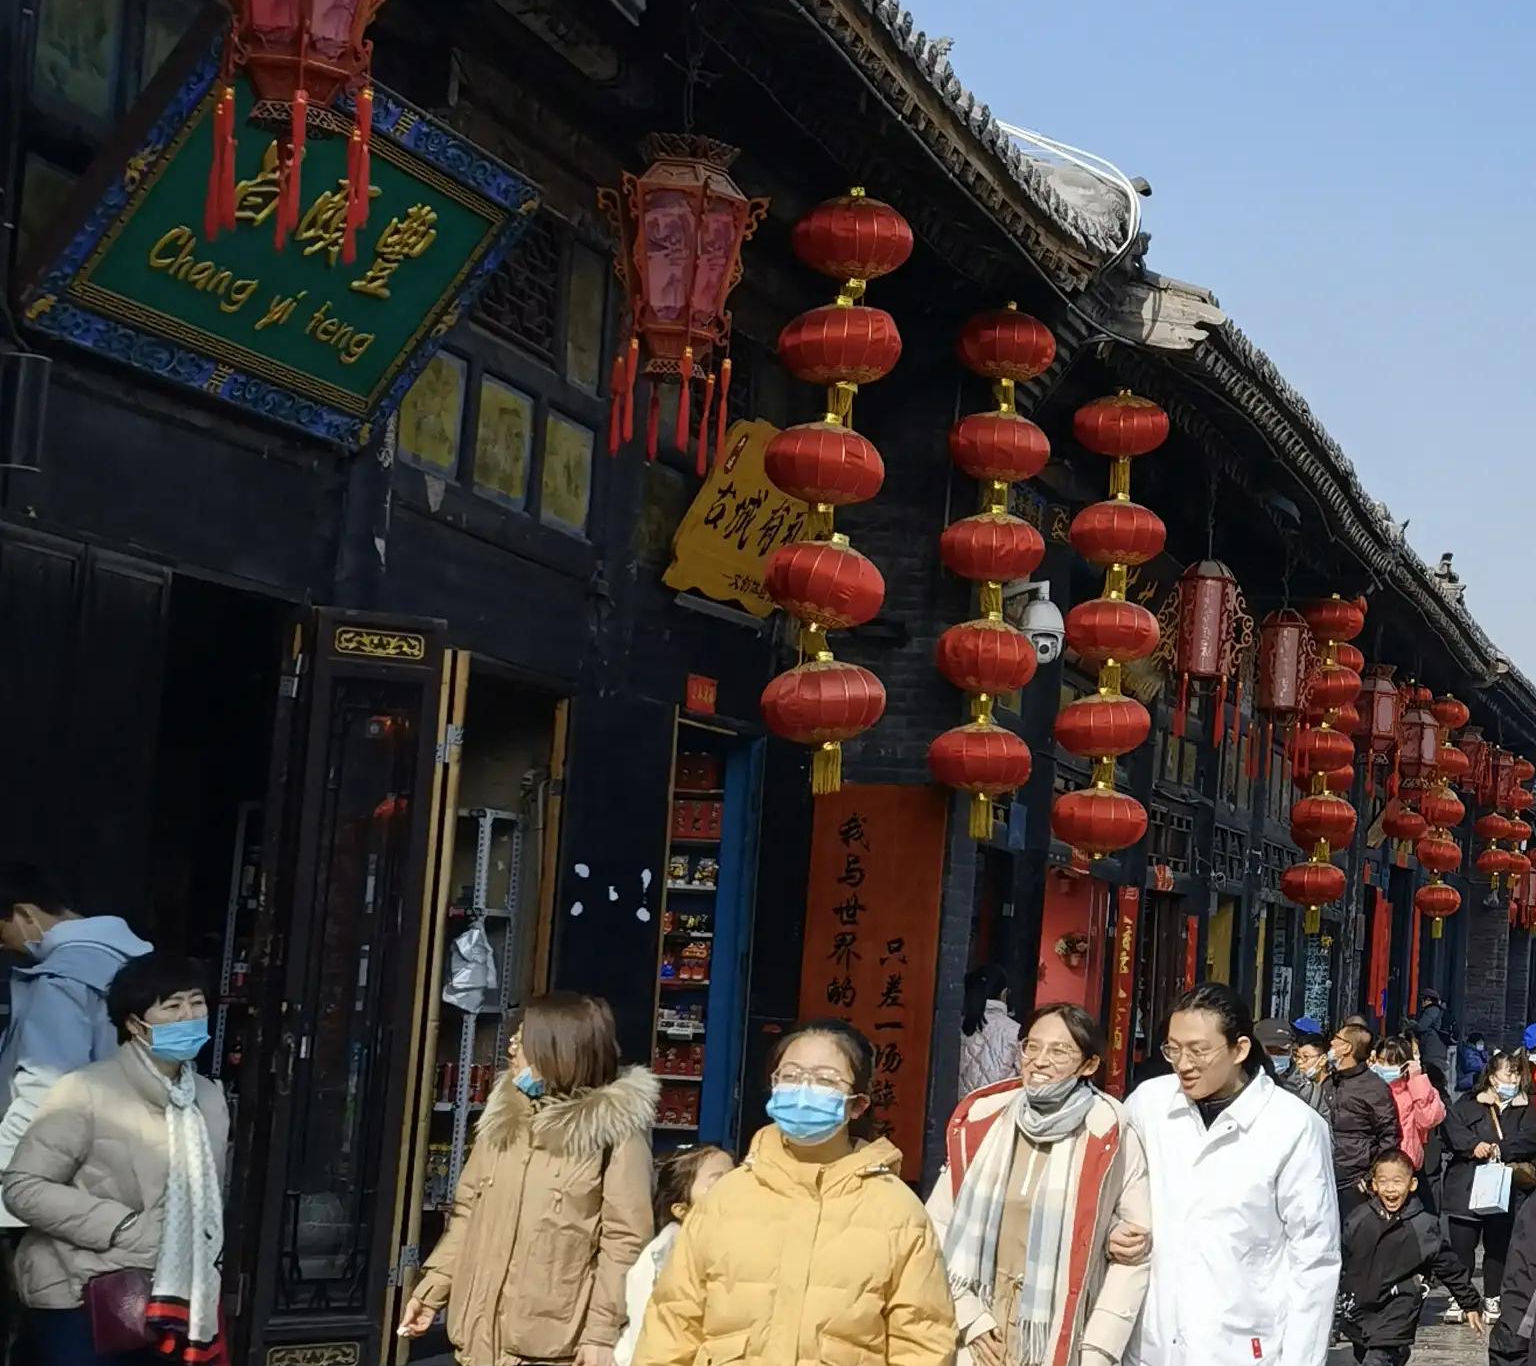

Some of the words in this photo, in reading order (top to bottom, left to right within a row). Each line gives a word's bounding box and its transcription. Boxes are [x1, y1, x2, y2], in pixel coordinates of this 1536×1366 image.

[149, 225, 260, 313] Chang
[254, 290, 308, 330] yi
[825, 811, 870, 1028] 我与世界的
